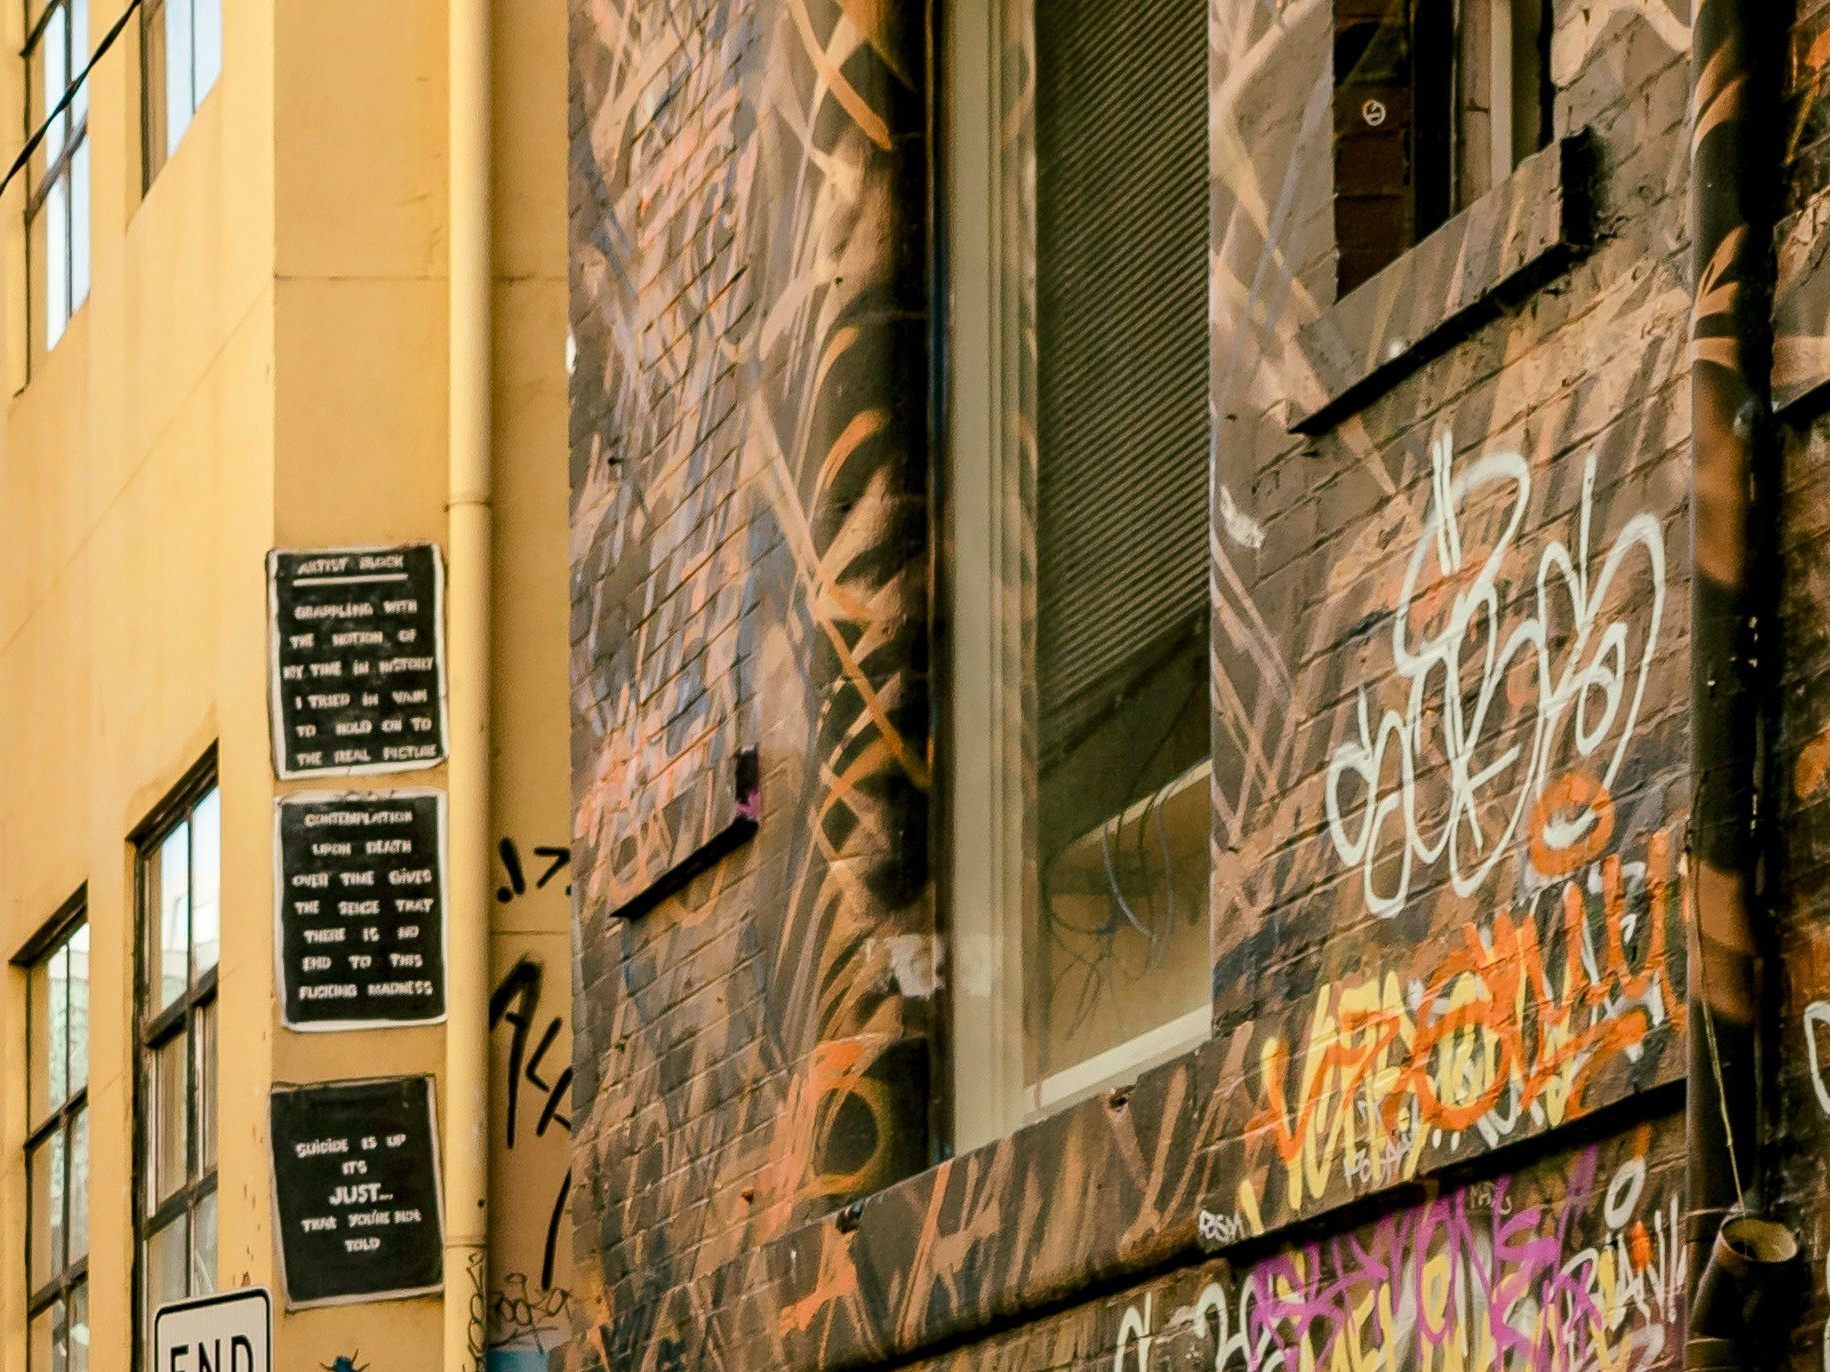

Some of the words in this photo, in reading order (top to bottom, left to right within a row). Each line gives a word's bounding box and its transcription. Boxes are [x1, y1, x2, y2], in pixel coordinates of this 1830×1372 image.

[383, 600, 417, 614] WITH
[289, 633, 314, 649] THE
[398, 629, 417, 642] OF
[283, 665, 303, 680] MY
[309, 661, 341, 677] TIME
[308, 694, 350, 709] TRIED
[296, 725, 316, 737] TO
[335, 720, 372, 735] HOLD
[381, 719, 402, 732] ON
[410, 717, 432, 731] TO
[297, 752, 322, 766] THE
[334, 749, 371, 763] REAL
[383, 744, 437, 760] PICTURE
[304, 811, 412, 827] CONTEMPLATION
[313, 843, 351, 856] UPON
[366, 840, 412, 855] DEATH
[292, 872, 329, 887] OVER
[340, 871, 374, 886] TIME
[295, 901, 319, 915] THE
[338, 901, 380, 915] SENSE
[395, 899, 433, 912] THAT
[304, 928, 346, 944] THERE
[363, 927, 379, 942] IS
[397, 925, 419, 939] NO
[302, 956, 332, 971] END
[349, 955, 372, 969] TO
[390, 953, 423, 968] THIS
[299, 984, 357, 999] FUCKING
[367, 981, 433, 996] MADNESS
[361, 1136, 377, 1150] IS
[386, 1134, 406, 1147] UP
[342, 1160, 367, 1175] ITS
[344, 1238, 380, 1252] TOLD
